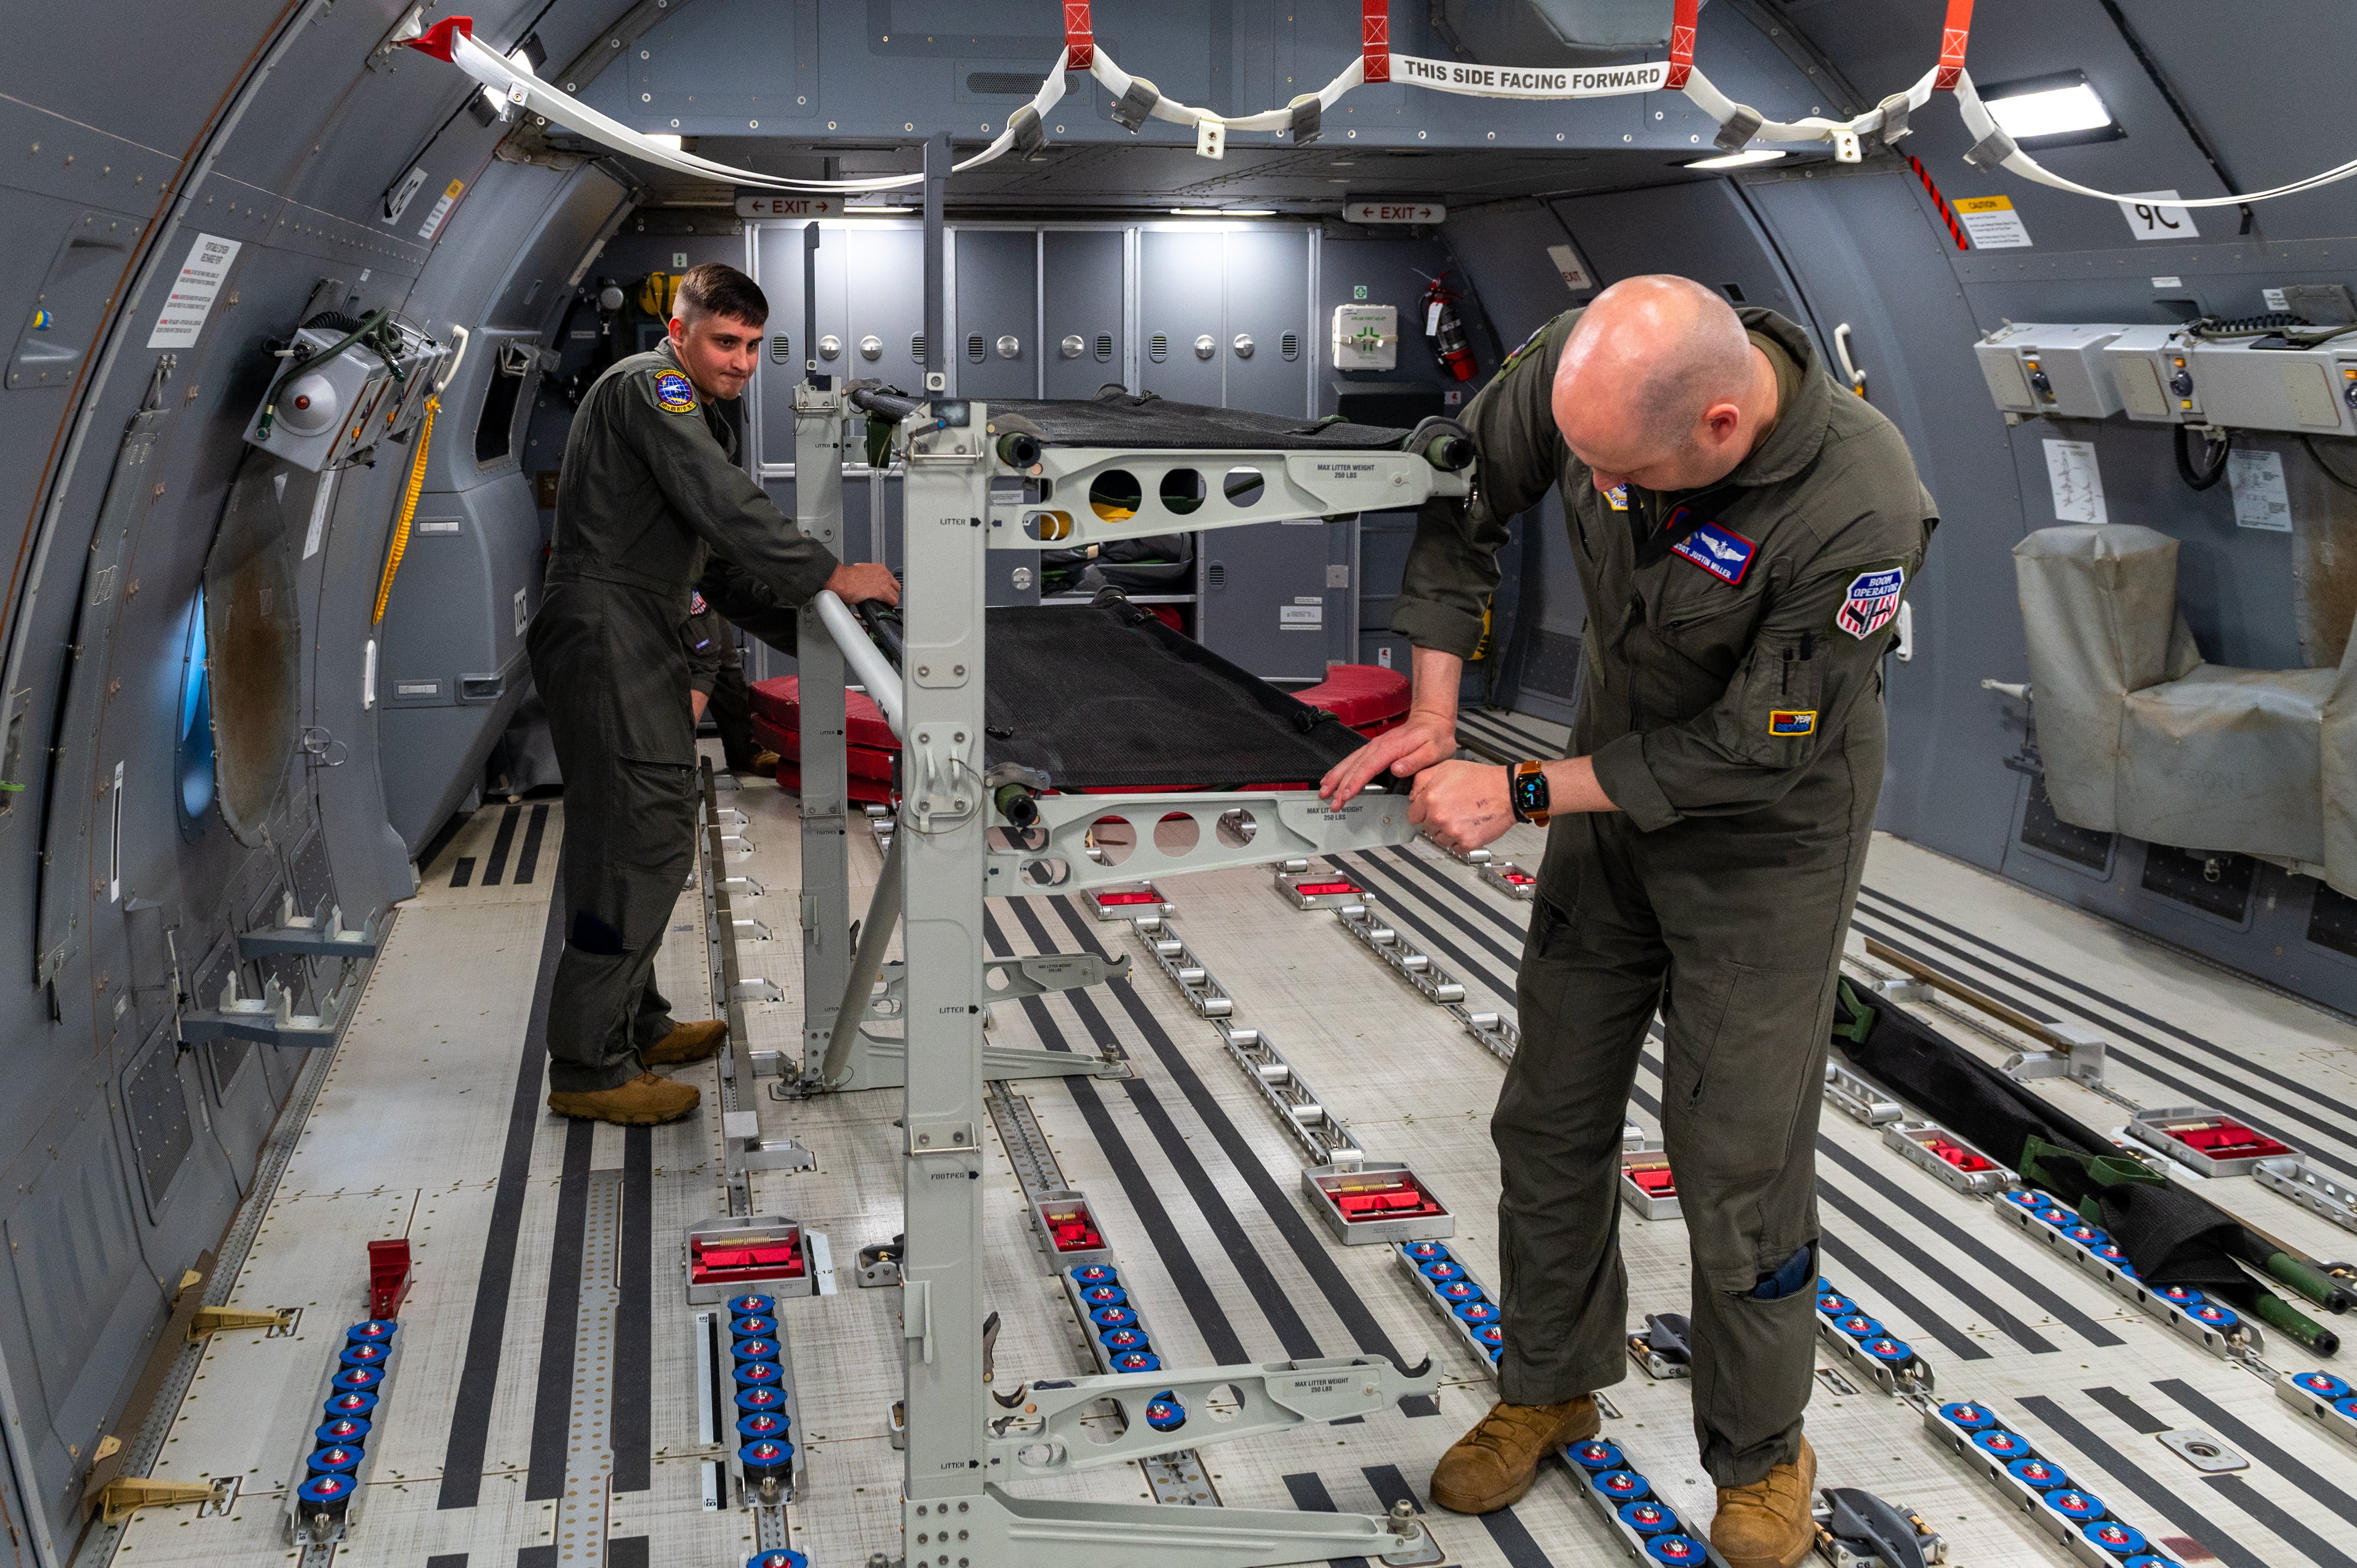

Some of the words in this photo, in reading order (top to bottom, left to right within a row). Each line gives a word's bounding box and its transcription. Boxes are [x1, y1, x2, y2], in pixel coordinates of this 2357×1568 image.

[1405, 60, 1447, 81] THIS
[1452, 66, 1494, 87] SIDE
[1501, 72, 1566, 90] FACING
[1573, 68, 1661, 89] FORWARD
[773, 200, 810, 213] EXIT
[1381, 206, 1415, 219] EXIT
[657, 369, 684, 378] INSTRUCTOR
[1690, 550, 1711, 566] JUSTIN
[1711, 563, 1731, 578] MILLER
[1869, 575, 1893, 587] BOOM
[1853, 583, 1899, 597] OPERATOR
[516, 595, 526, 628] 10C
[1794, 715, 1812, 724] YEAH
[931, 1172, 964, 1180] FOOTPEG
[706, 1498, 716, 1507] B7
